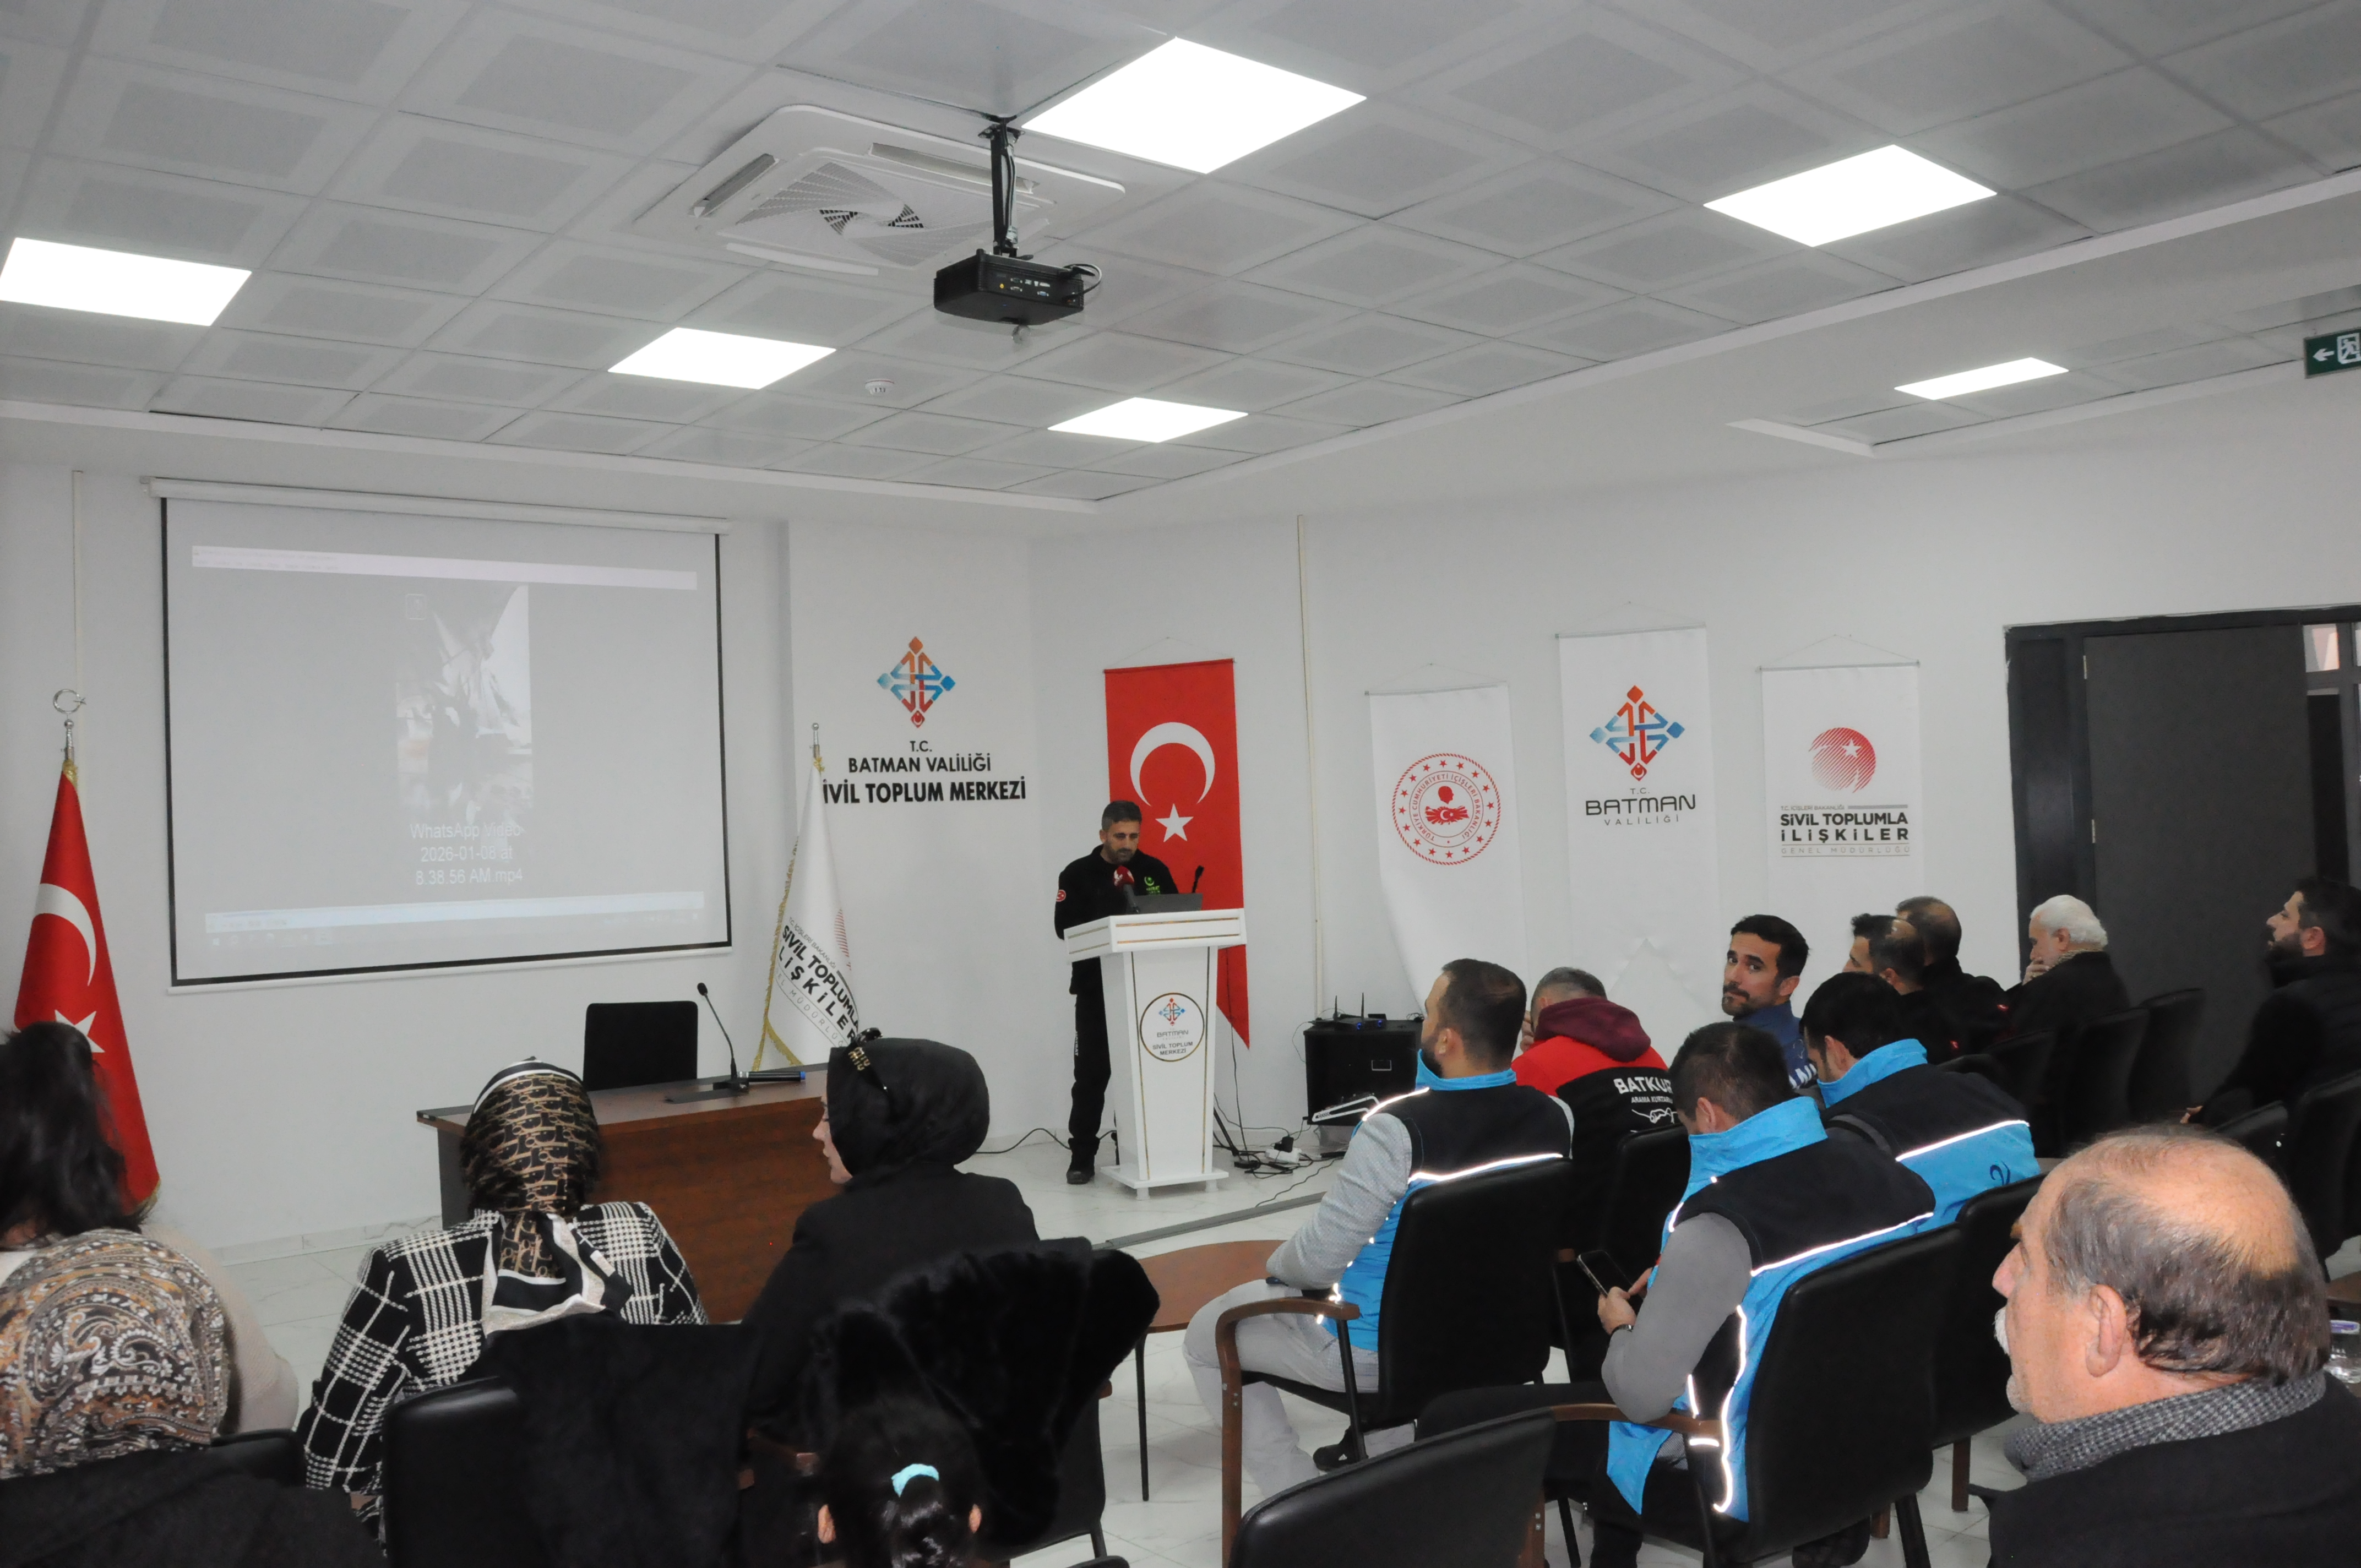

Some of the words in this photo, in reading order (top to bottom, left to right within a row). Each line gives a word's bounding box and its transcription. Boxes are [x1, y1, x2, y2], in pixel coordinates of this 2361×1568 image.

[910, 740, 932, 752] T.C.
[848, 757, 920, 773] BATMAN
[927, 753, 991, 772] VALİLİĞİ
[823, 778, 860, 804] İVİL
[866, 782, 944, 803] TOPLUM
[950, 776, 1026, 801] MERKEZİ
[1412, 773, 1449, 810] CUMHURİYETİ
[1451, 774, 1478, 797] İÇİŞLERİ
[1586, 794, 1696, 815] BATMAN
[1413, 813, 1434, 841] TÜRKİYE
[1462, 799, 1481, 840] BAKANLIĞI
[1604, 814, 1679, 826] VALİLİĞİ
[1781, 814, 1819, 826] SİVİL
[1823, 812, 1908, 826] TOPLUMLA
[410, 823, 480, 840] WhatsApp
[484, 822, 521, 837] Video
[1781, 828, 1909, 843] İLİŞKİLER
[421, 846, 496, 862] 2026-01-08
[501, 846, 513, 860] at
[416, 869, 465, 885] 8.38.56
[782, 925, 807, 961] SİVİL
[808, 955, 858, 1033] TOPLUMLA
[779, 945, 857, 1043] LİŞKİLER
[790, 989, 844, 1047] MÜDÜRLÜĞ
[1613, 1076, 1673, 1094] BATKUR
